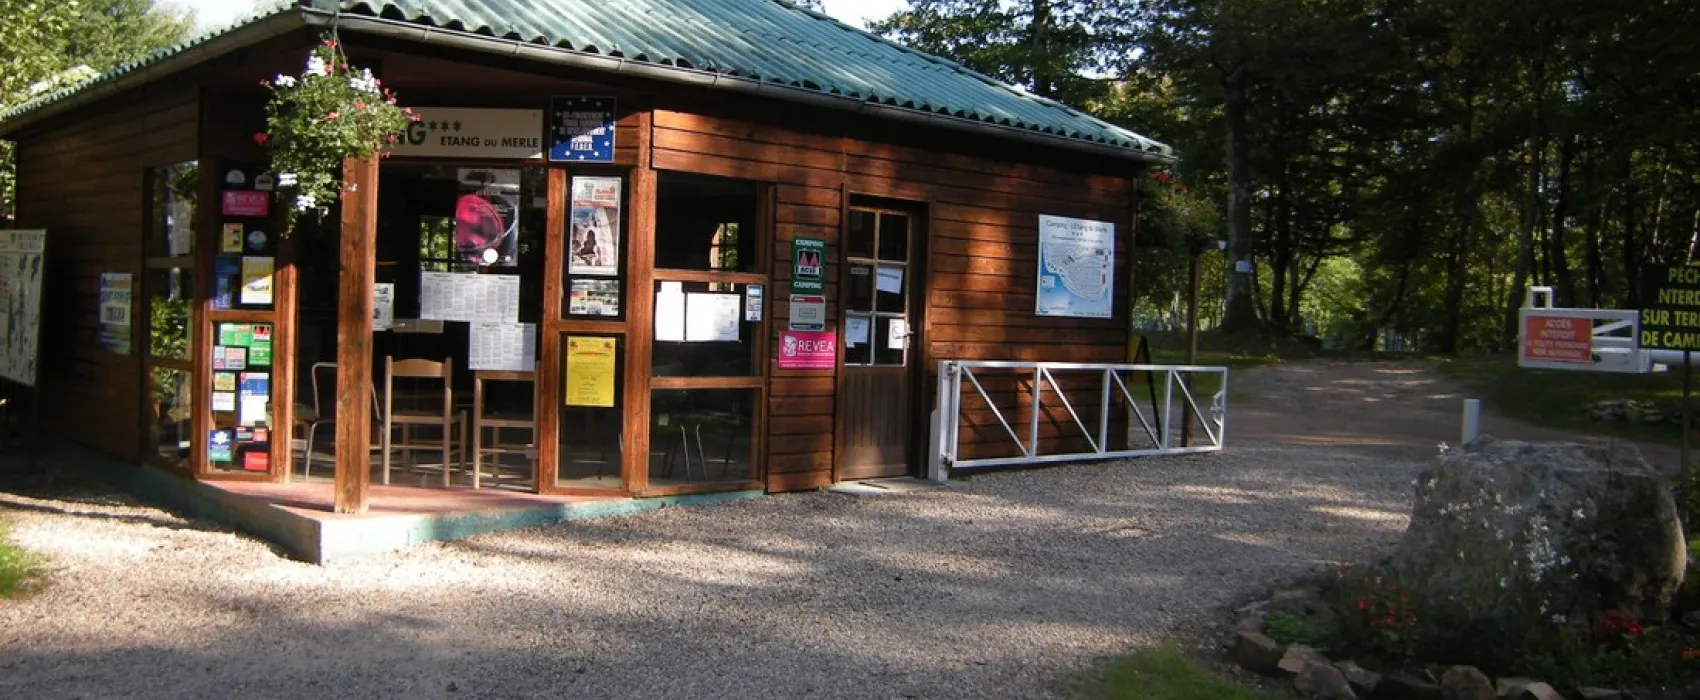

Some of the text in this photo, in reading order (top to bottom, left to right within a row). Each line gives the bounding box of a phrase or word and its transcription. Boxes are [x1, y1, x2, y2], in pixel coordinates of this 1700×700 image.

[501, 137, 539, 148] MERLE
[795, 239, 824, 247] CAMPING
[793, 281, 823, 289] CAMPING
[1642, 308, 1700, 328] SUR TER
[1641, 330, 1659, 346] DE
[798, 339, 834, 352] REVEA
